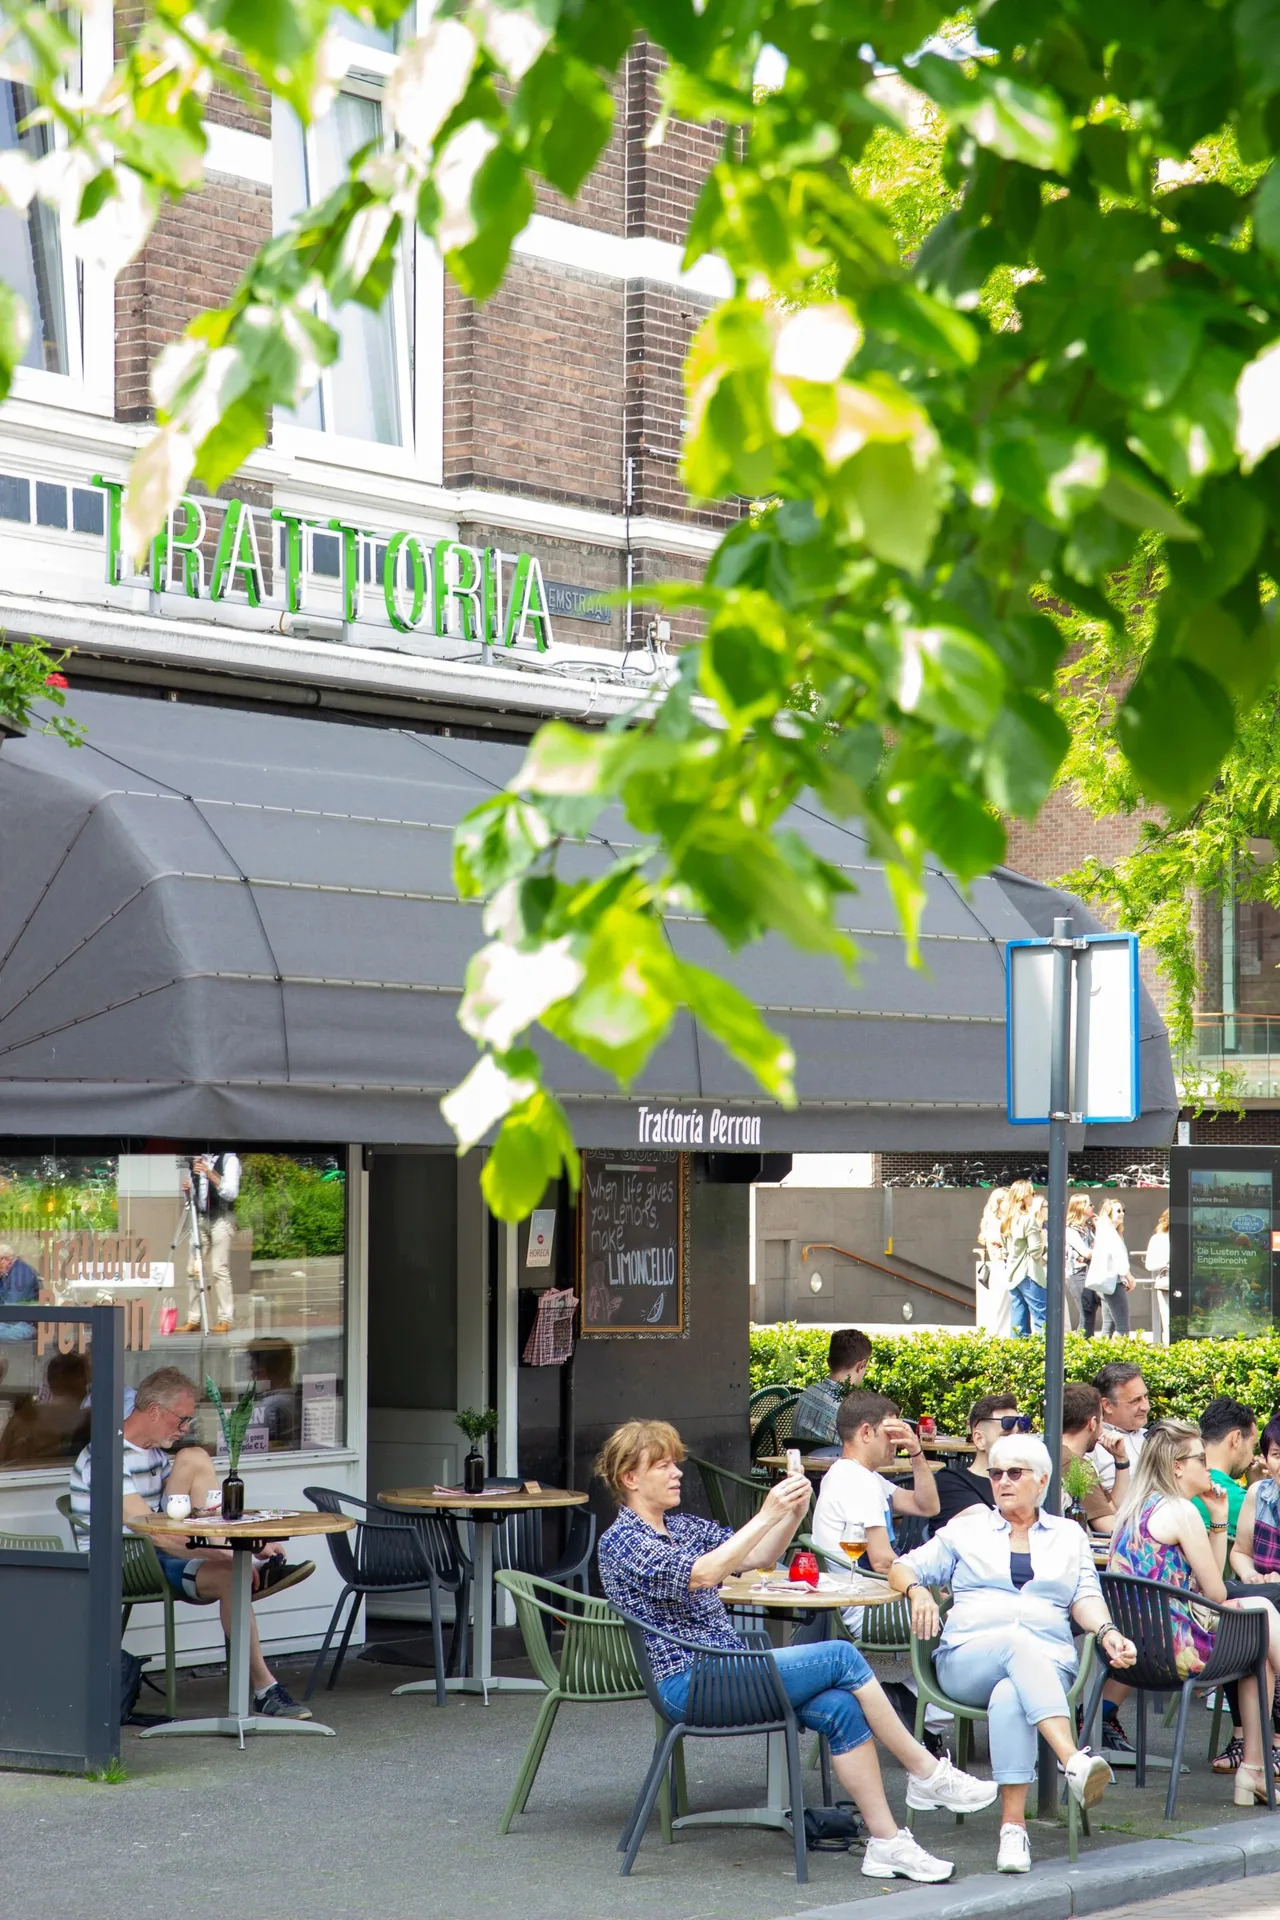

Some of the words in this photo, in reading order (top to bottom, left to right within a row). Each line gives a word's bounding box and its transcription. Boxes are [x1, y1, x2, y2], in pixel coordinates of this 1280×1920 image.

[91, 474, 555, 653] TRATTORIA
[638, 1106, 704, 1144] Trattoria
[710, 1108, 762, 1146] Perron
[586, 1174, 618, 1201] When
[644, 1177, 674, 1210] gives
[591, 1205, 610, 1227] you
[39, 1229, 151, 1283] Trattoria
[591, 1225, 626, 1252] make
[1210, 1248, 1240, 1257] Lusten
[1241, 1249, 1257, 1257] van
[608, 1246, 676, 1287] LIMONCELLO
[1197, 1256, 1248, 1265] Engelbrecht
